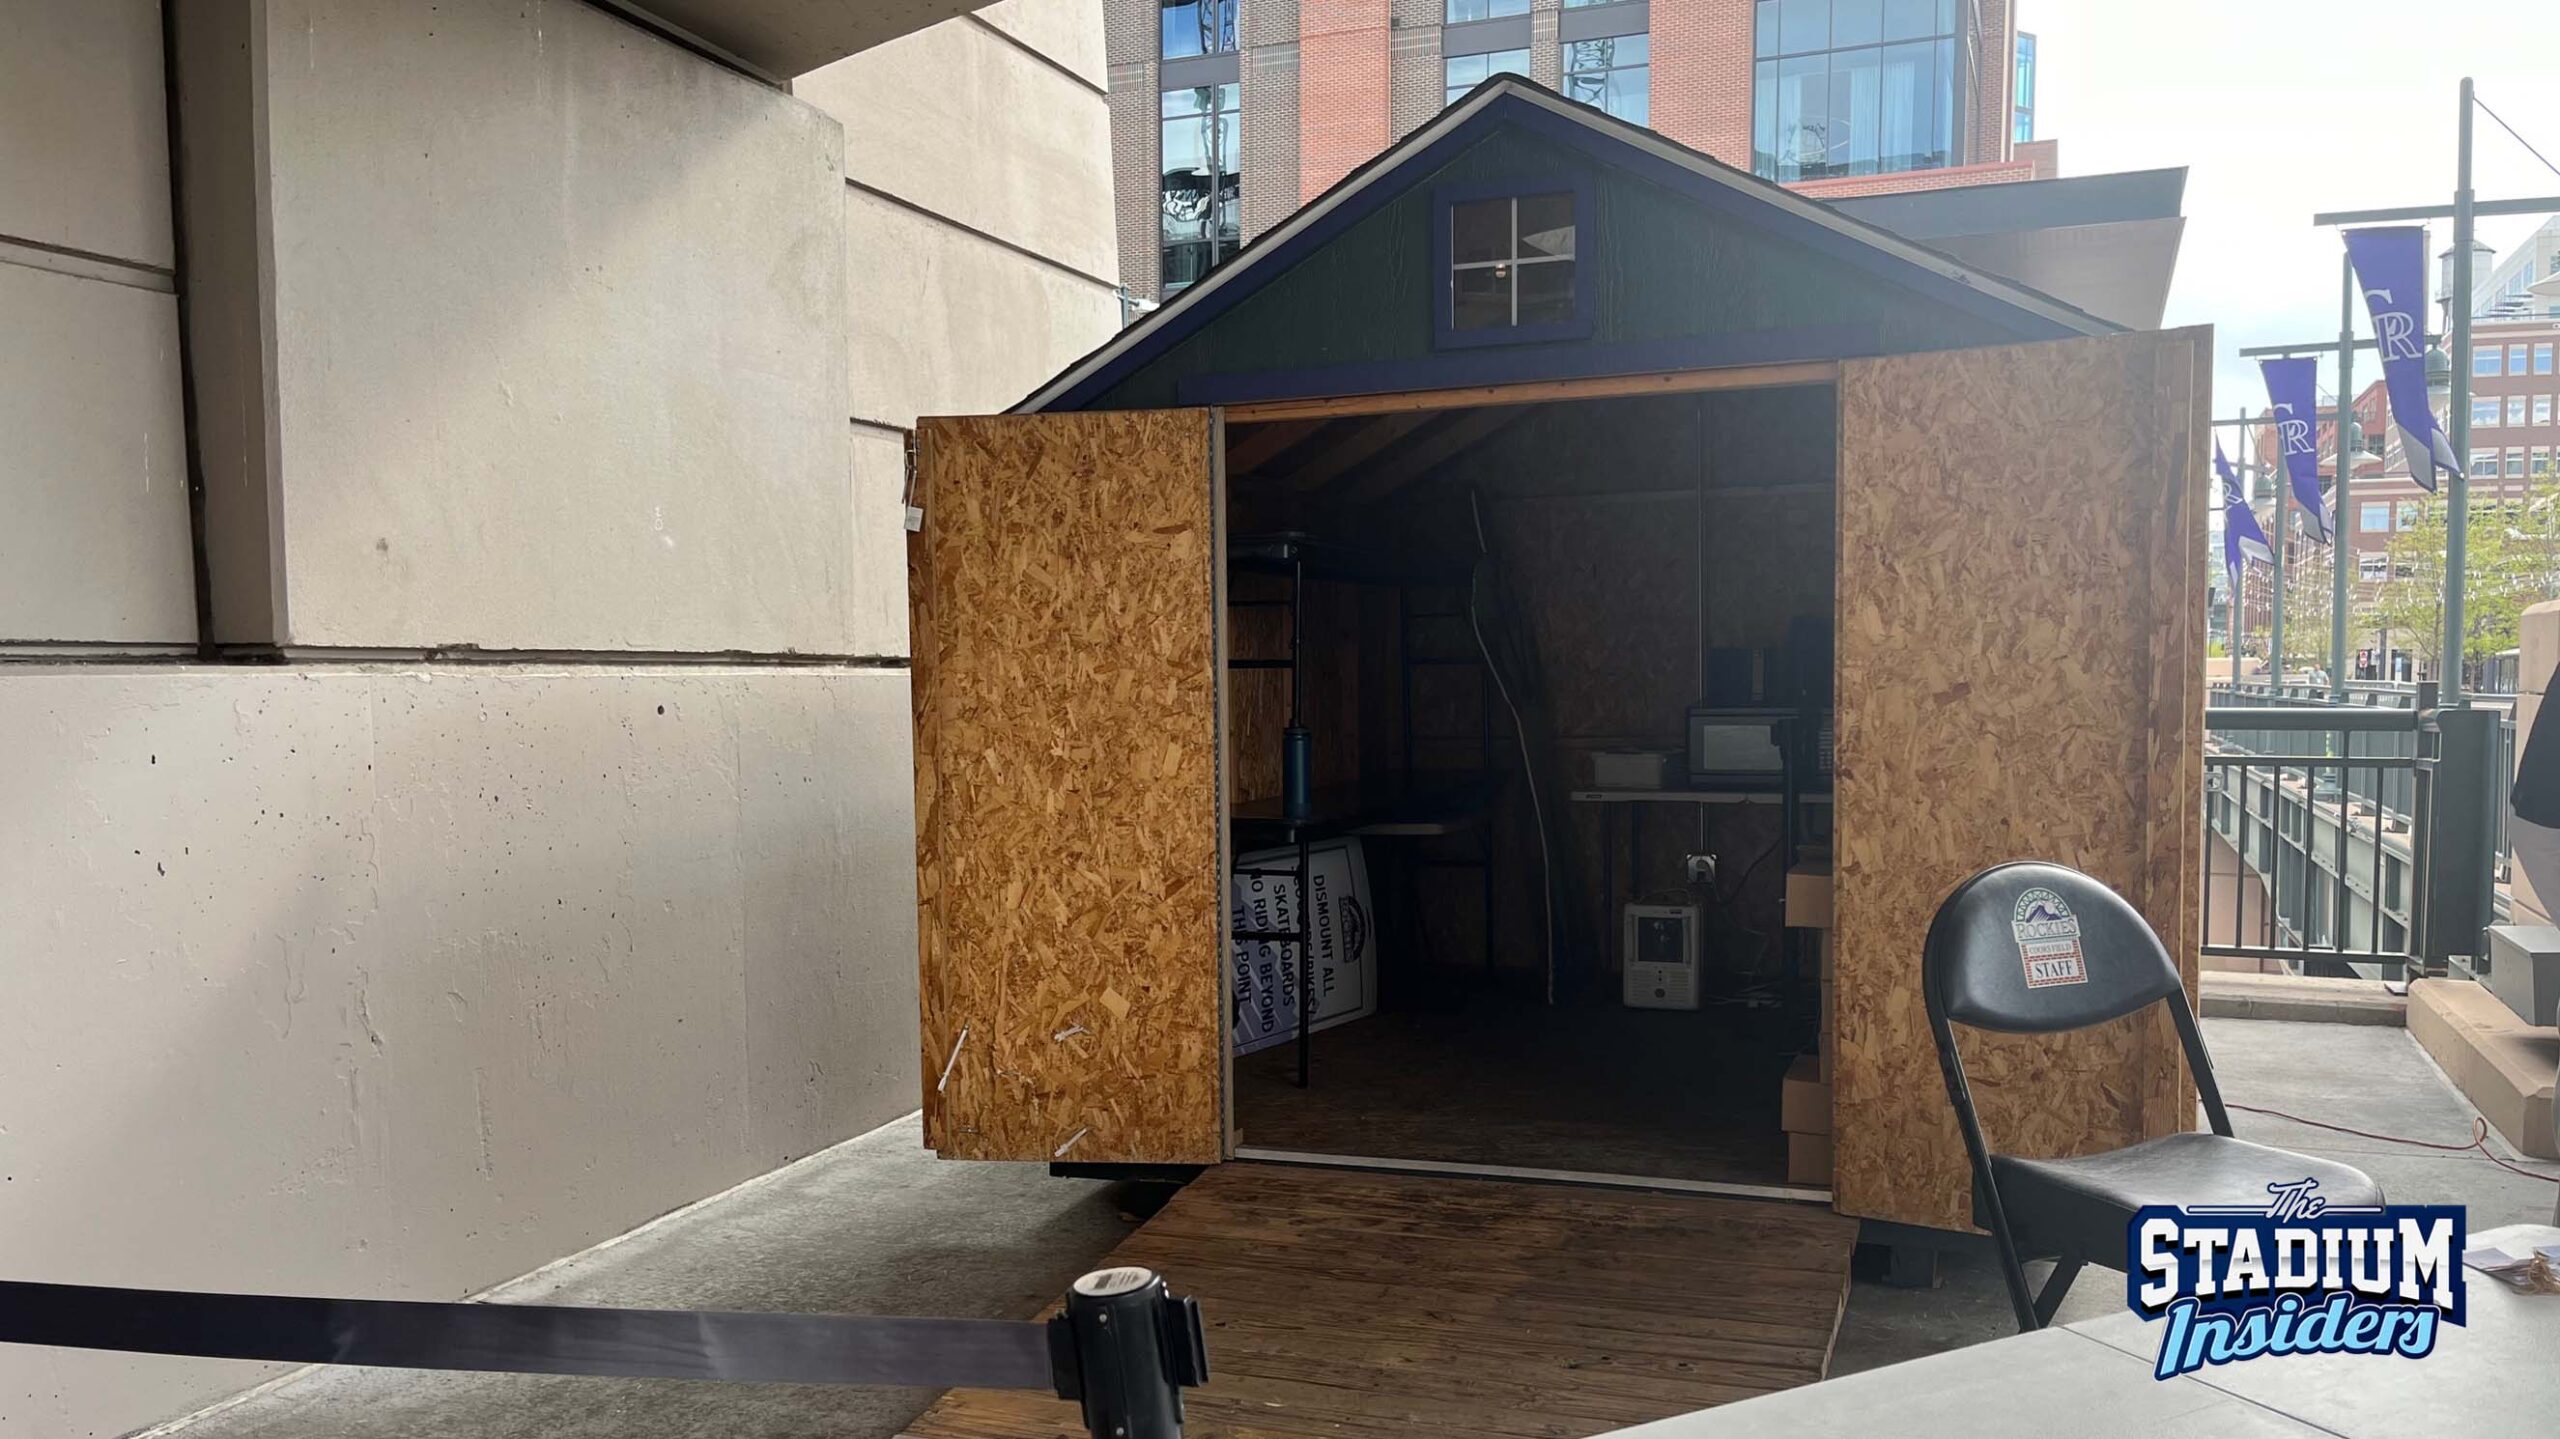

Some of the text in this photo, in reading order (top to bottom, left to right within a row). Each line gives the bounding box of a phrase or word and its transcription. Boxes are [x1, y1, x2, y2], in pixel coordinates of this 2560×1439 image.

[1273, 884, 1295, 1007] SKATEBOARDS
[1313, 875, 1335, 997] DISMOUNT ALL
[2015, 918, 2076, 939] ROCKIES
[1236, 951, 1252, 1003] POINT
[1259, 962, 1275, 1033] BEYOND
[2035, 960, 2073, 979] STAFF
